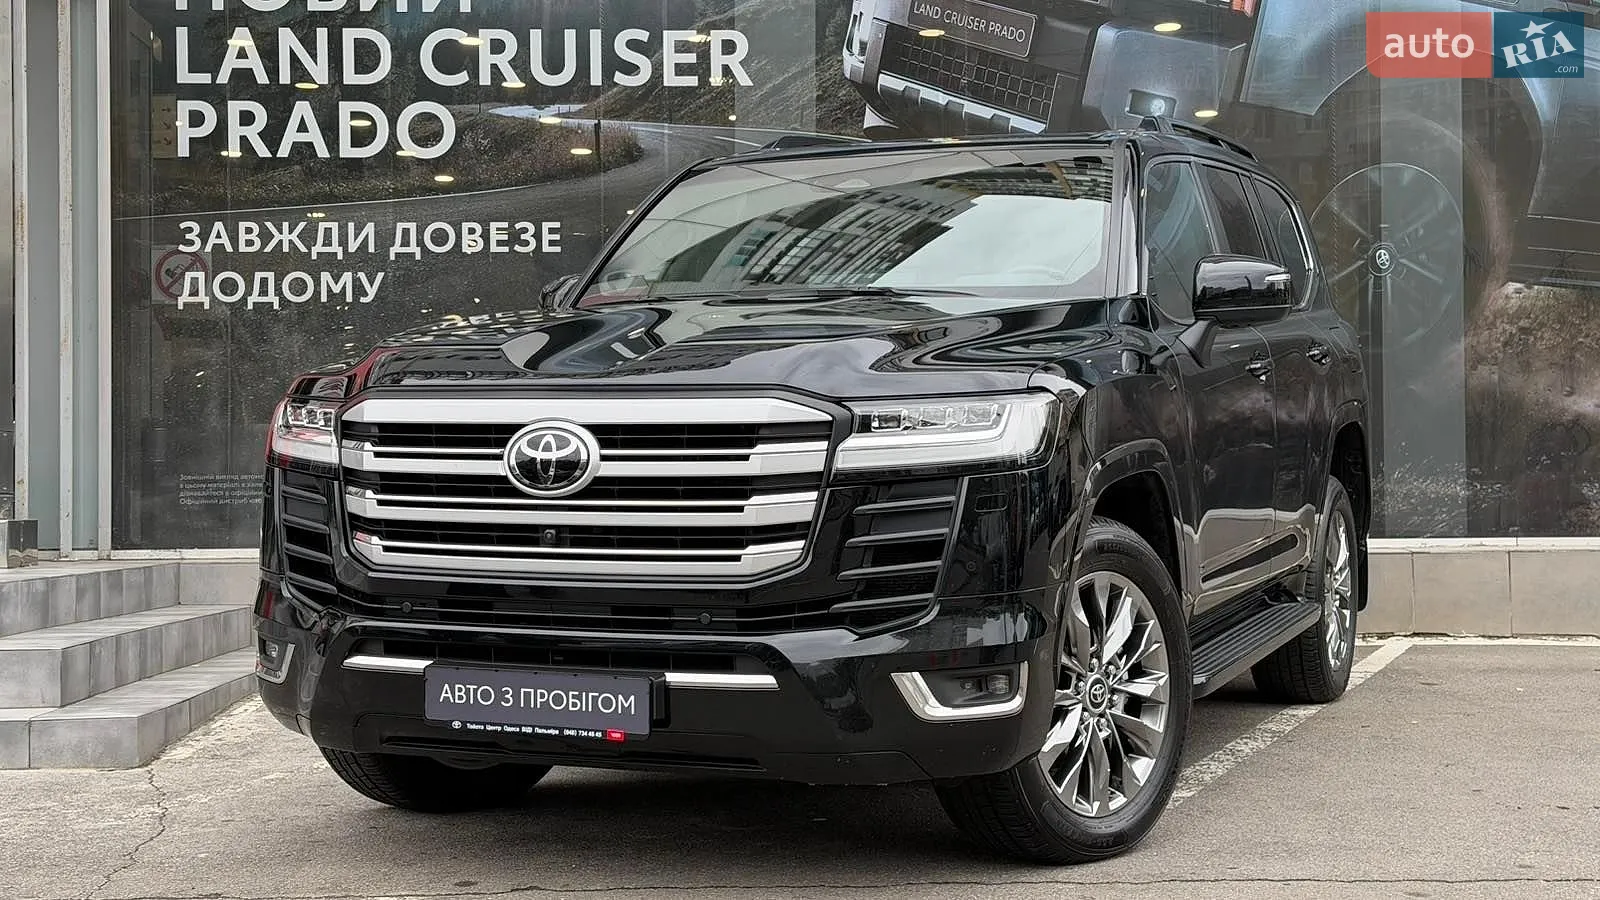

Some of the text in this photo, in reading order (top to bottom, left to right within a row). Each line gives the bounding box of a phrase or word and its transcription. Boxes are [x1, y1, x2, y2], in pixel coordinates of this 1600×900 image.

[914, 1, 1026, 42] LAND CRUISER PRADO
[175, 27, 753, 87] LAND CRUISER
[176, 100, 457, 159] PRADO
[178, 221, 562, 260] ЗАВЖДИ ДОВЕЗЕ
[177, 271, 385, 310] ДОДОМУ
[439, 683, 635, 715] АВТО З ПРОБІГОМ
